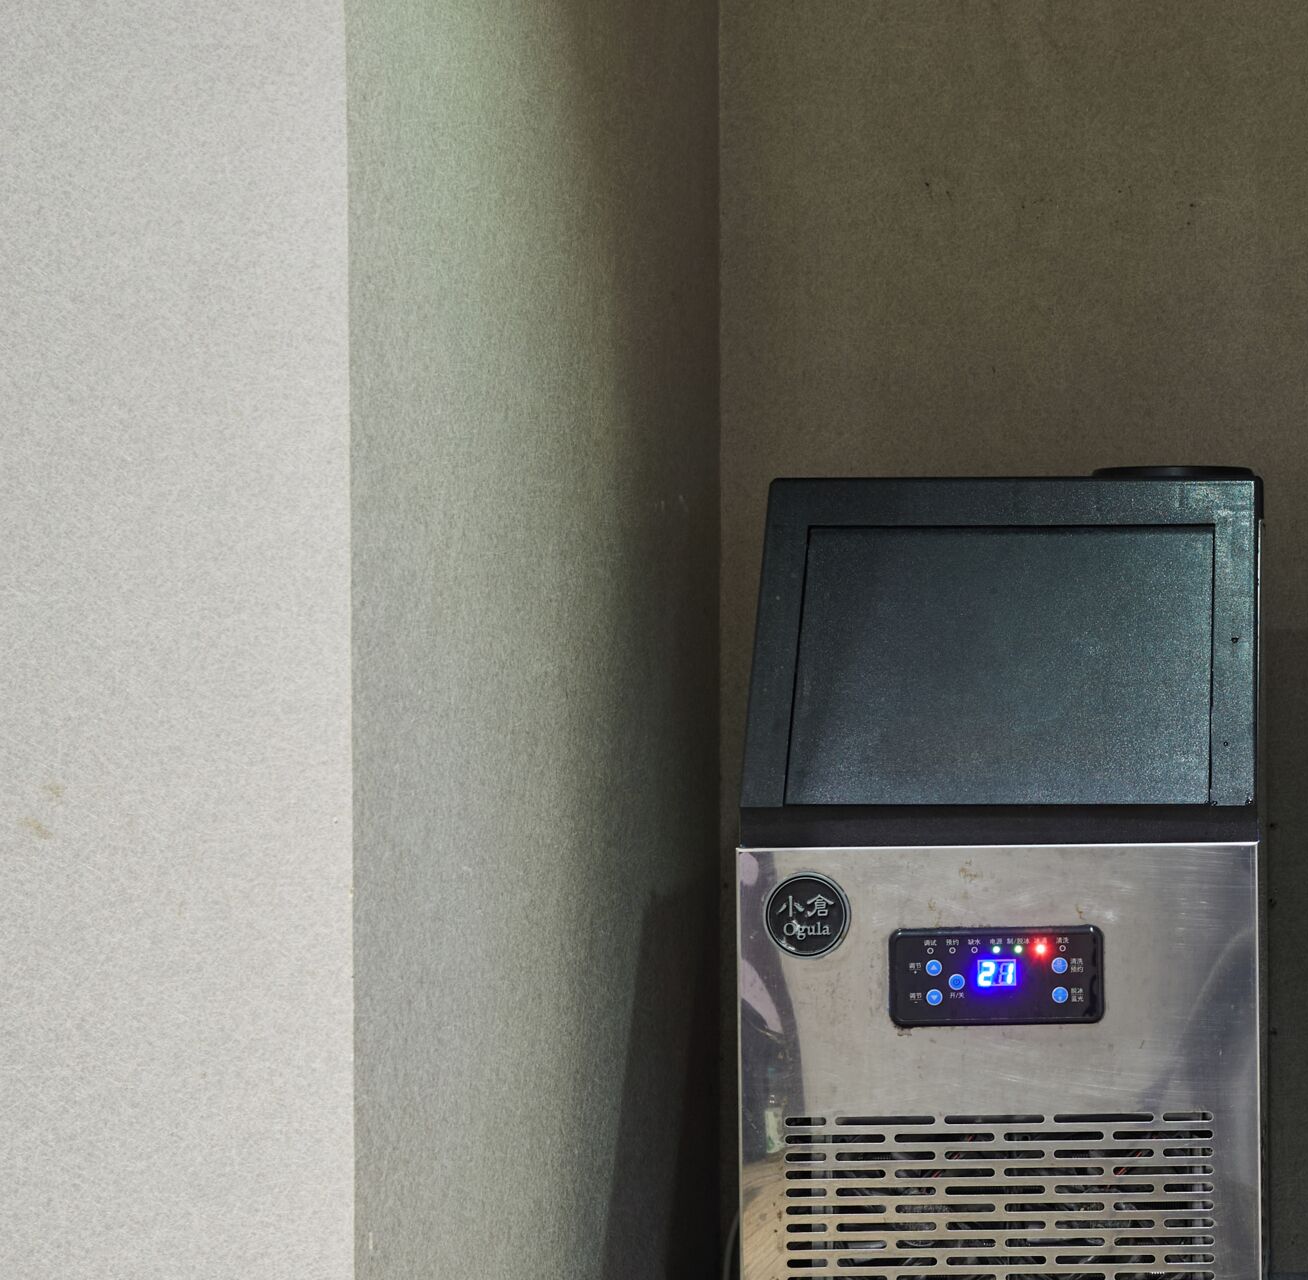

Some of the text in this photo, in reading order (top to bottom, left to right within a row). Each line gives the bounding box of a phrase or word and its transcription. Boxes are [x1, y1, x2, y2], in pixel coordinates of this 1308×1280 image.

[775, 893, 835, 918] 小倉
[783, 921, 832, 940] Ogula
[977, 961, 1015, 987] 21
